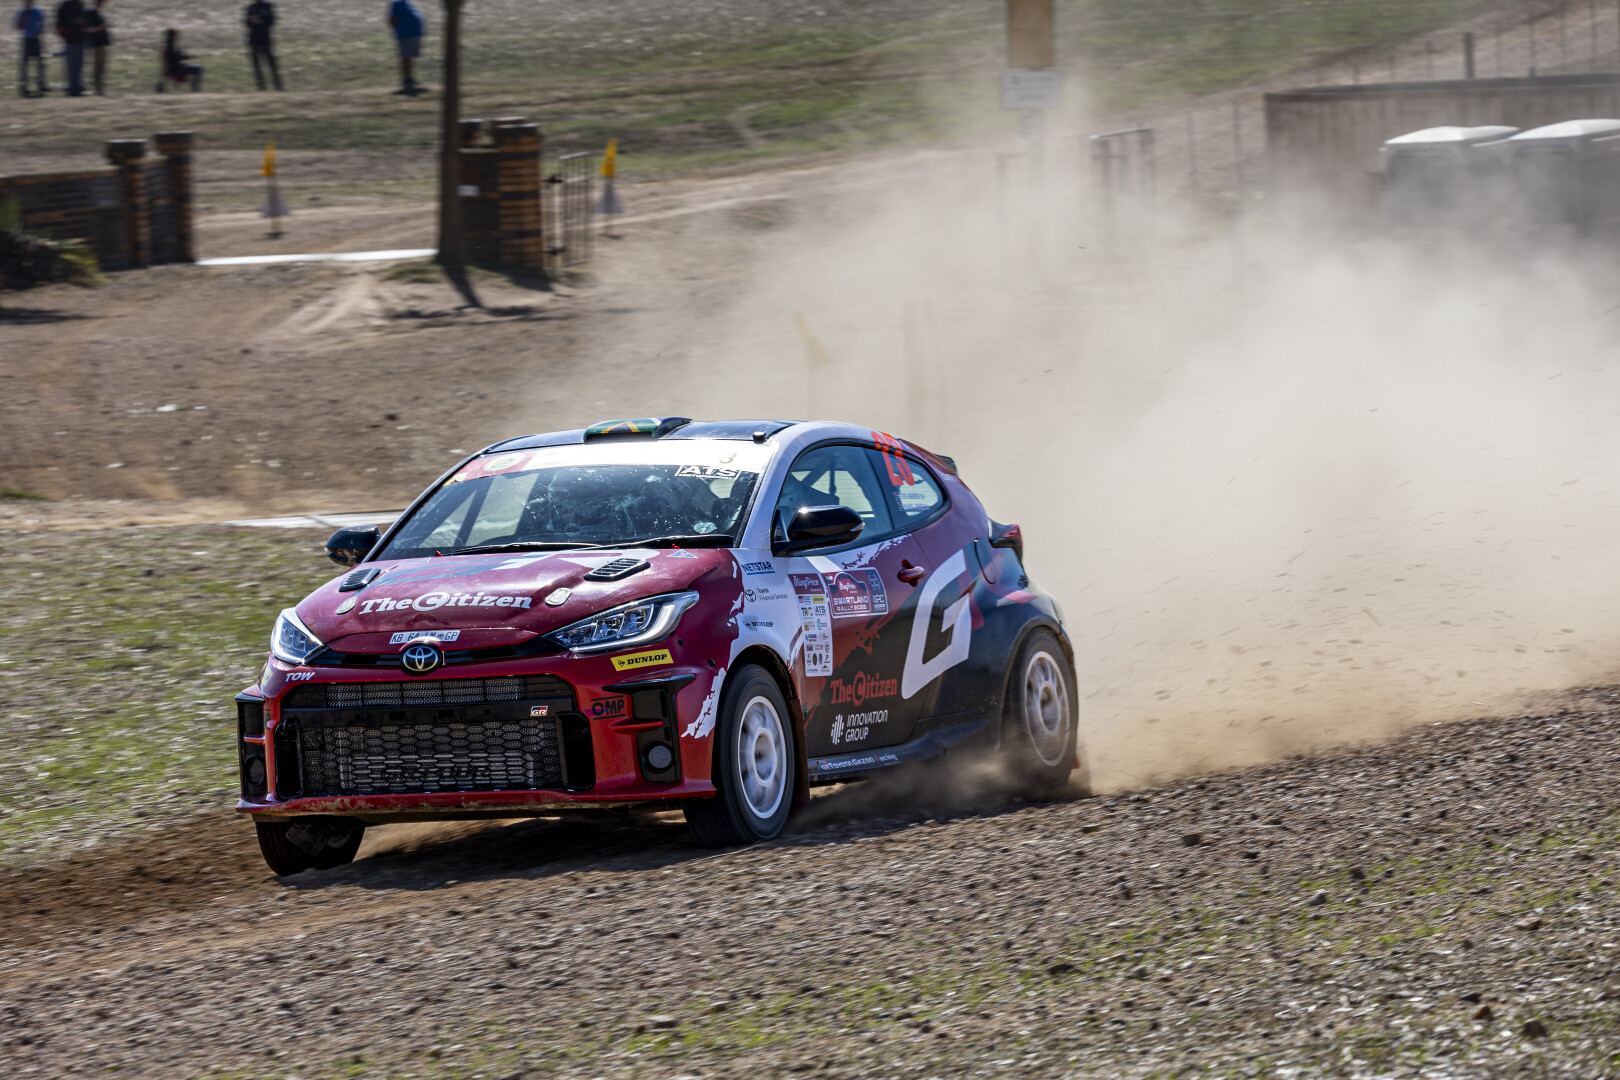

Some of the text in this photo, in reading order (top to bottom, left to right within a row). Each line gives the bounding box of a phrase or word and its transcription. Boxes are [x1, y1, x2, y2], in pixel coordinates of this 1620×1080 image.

[870, 431, 915, 486] 23
[681, 466, 736, 477] ATS
[741, 561, 773, 572] NETSTAR
[833, 595, 869, 606] SWARTLAND
[815, 605, 826, 614] ATS
[391, 633, 404, 643] KB
[444, 631, 459, 641] GP
[626, 653, 667, 665] DUNLOP
[285, 671, 315, 682] TOW
[591, 698, 625, 716] OMP
[845, 726, 869, 742] GROUP
[874, 753, 898, 763] Racing
